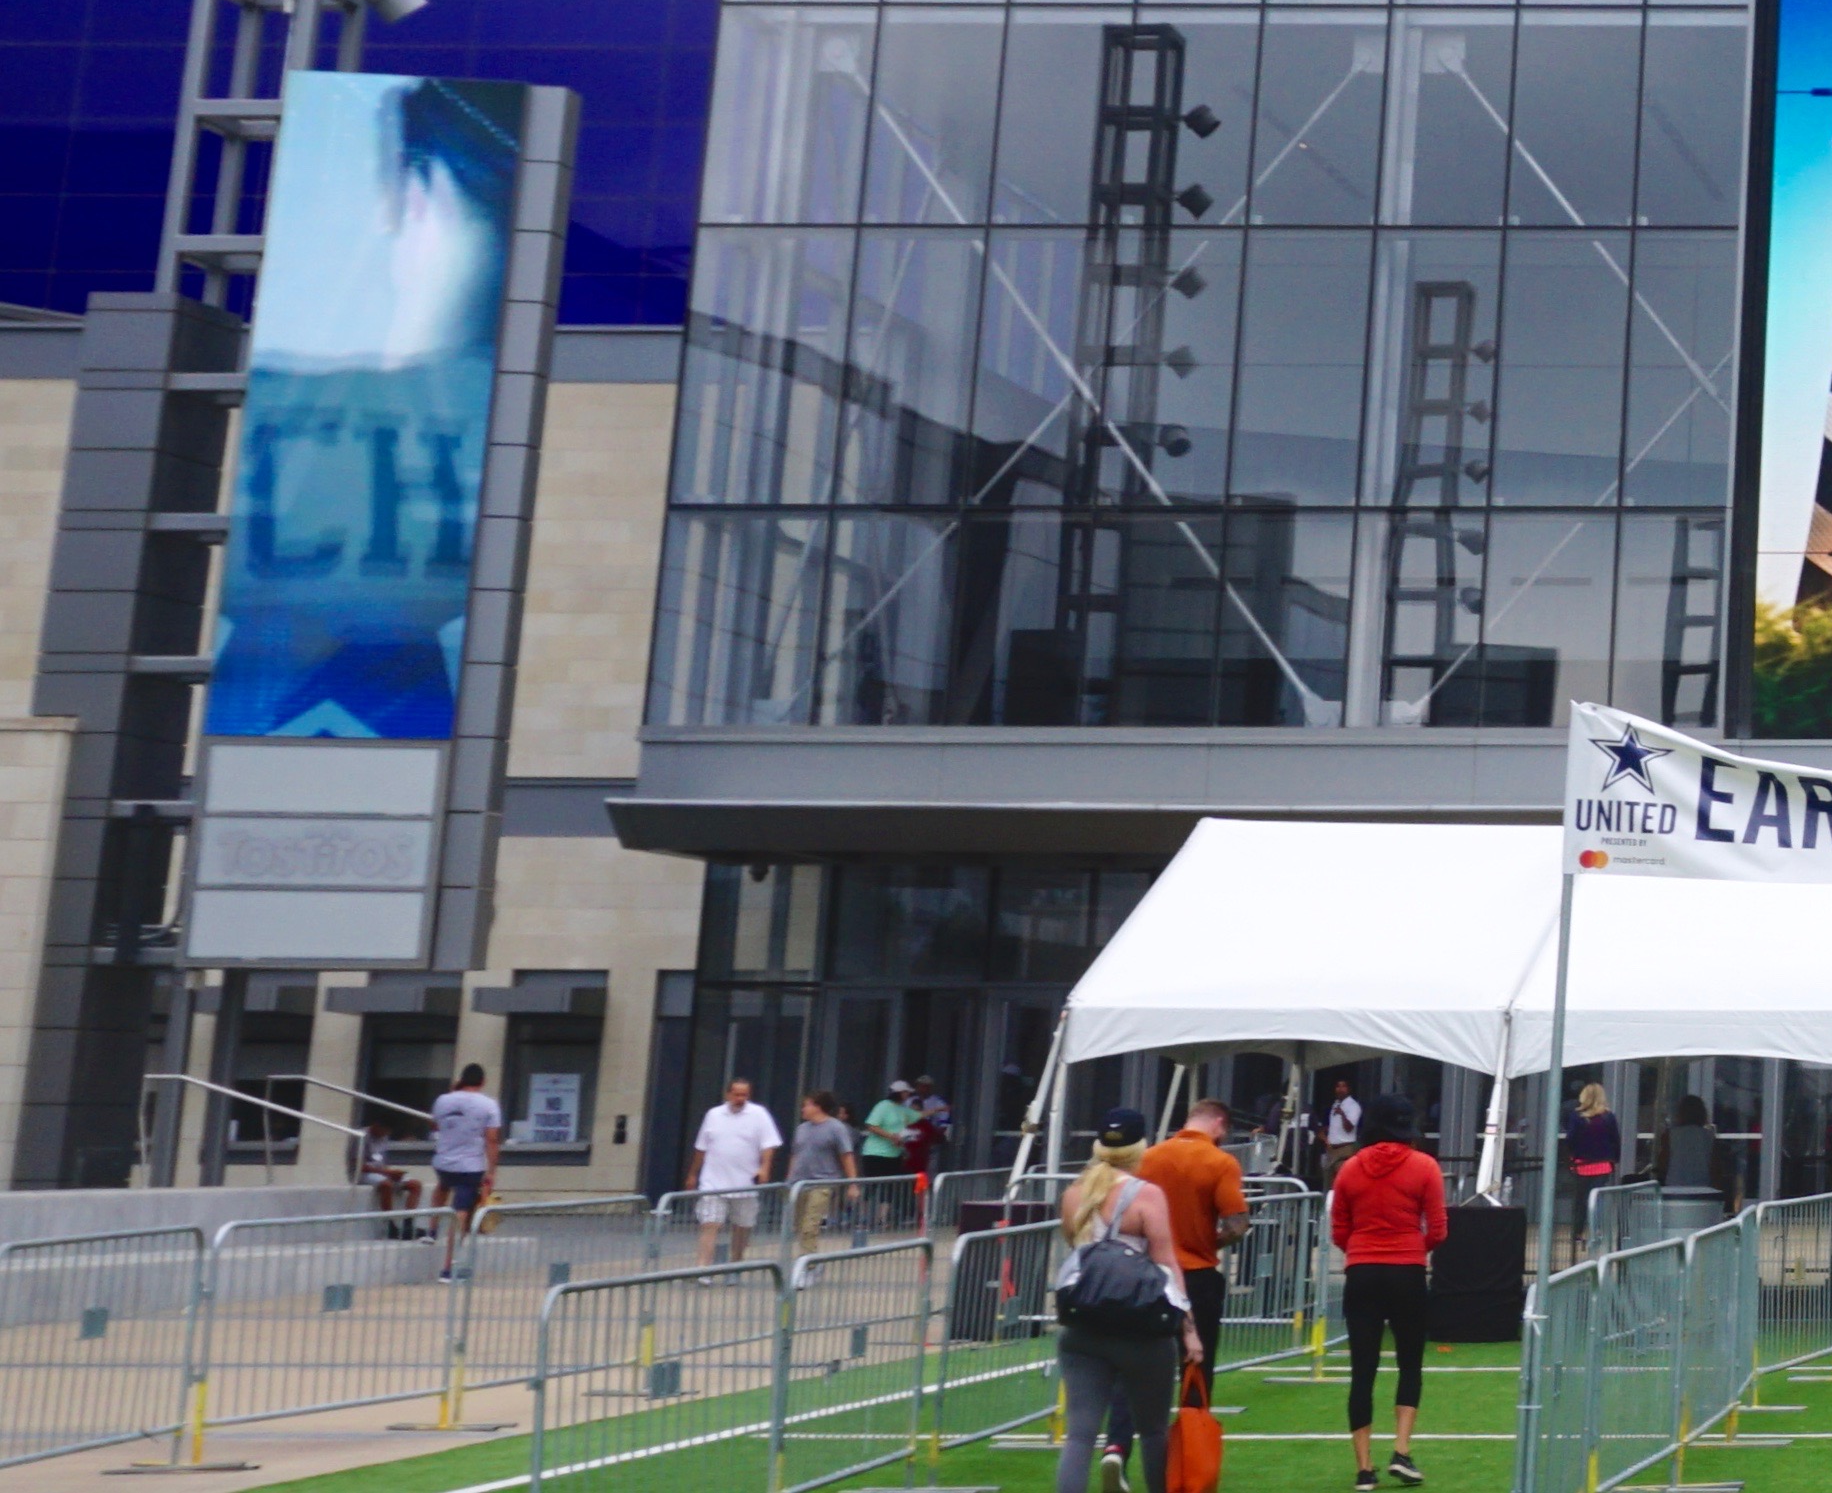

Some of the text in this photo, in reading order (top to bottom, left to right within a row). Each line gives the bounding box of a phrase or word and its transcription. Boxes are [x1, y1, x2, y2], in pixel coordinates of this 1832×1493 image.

[1575, 798, 1678, 835] UNITED
[1600, 836, 1647, 847] PRESENTED BY
[1613, 855, 1666, 866] mastercard
